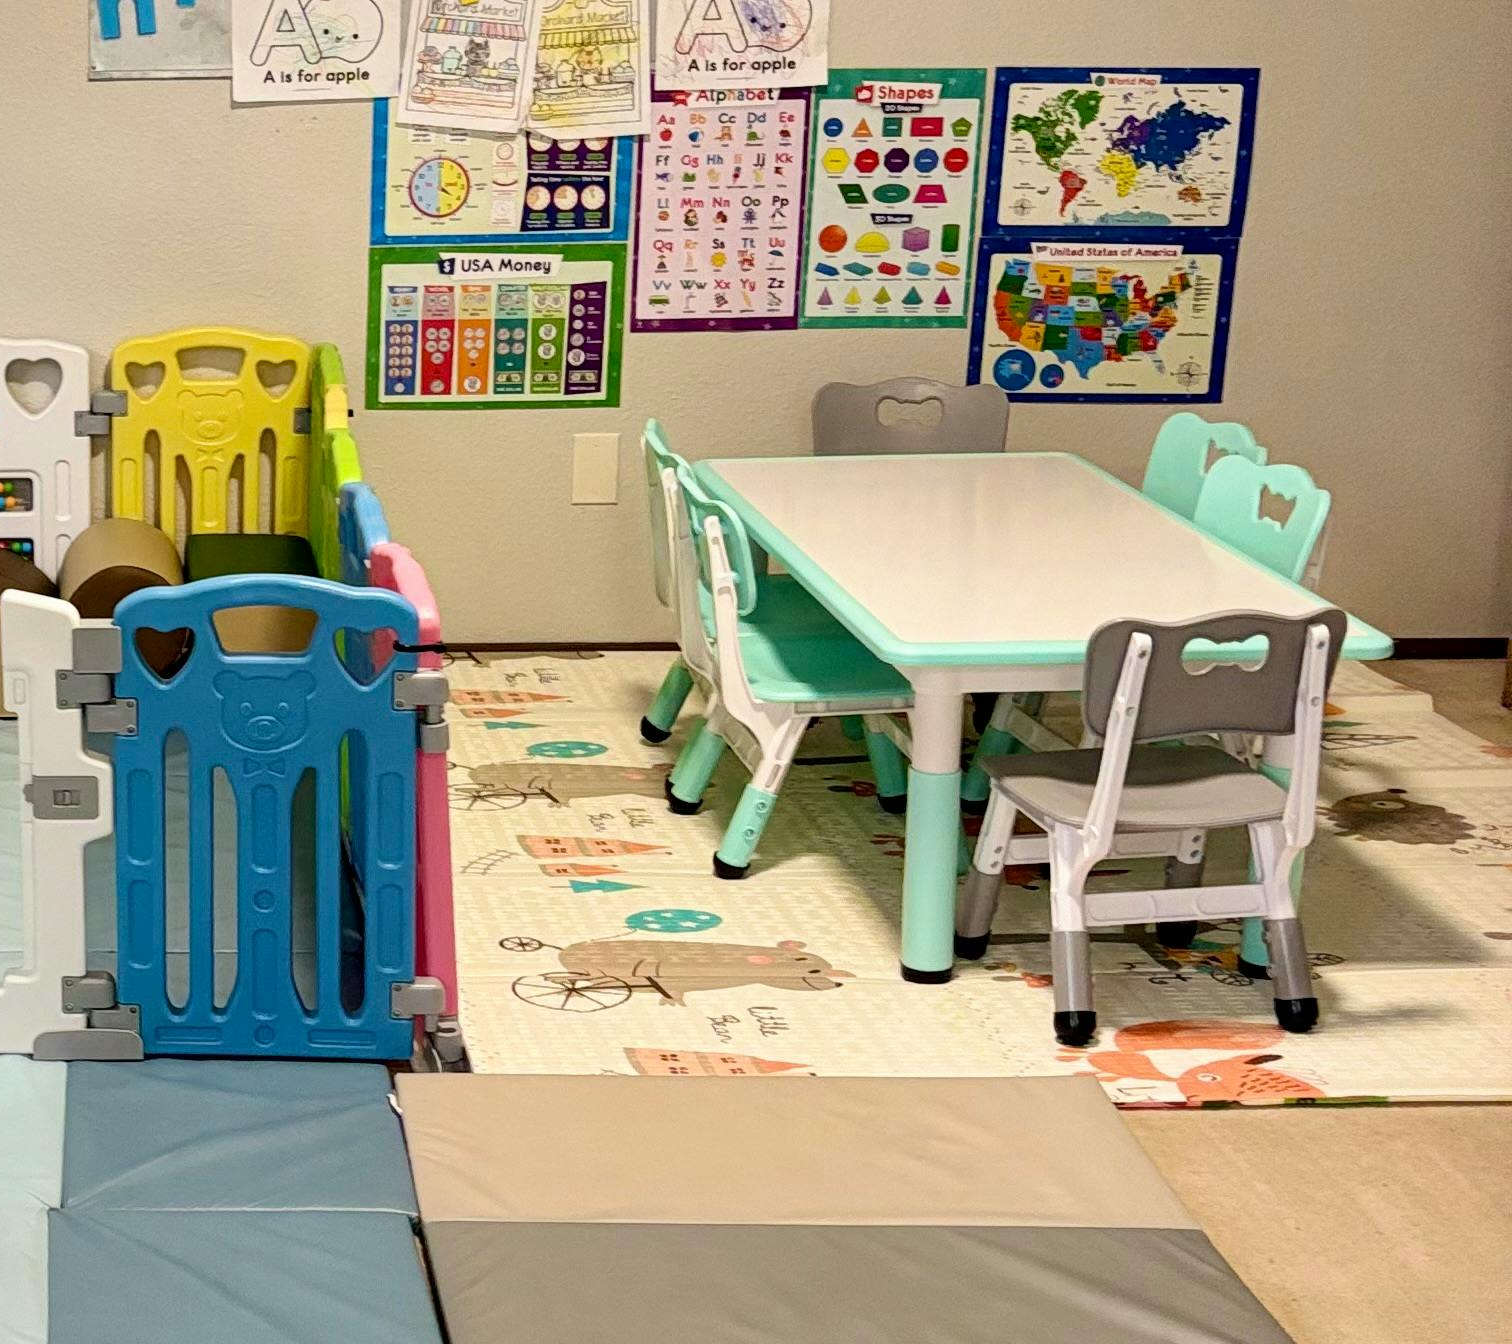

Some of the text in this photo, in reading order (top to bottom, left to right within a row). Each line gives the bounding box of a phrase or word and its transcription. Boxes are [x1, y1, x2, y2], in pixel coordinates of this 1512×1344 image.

[688, 57, 796, 74] A is for apple
[263, 67, 370, 85] A is for apple
[1108, 77, 1157, 86] World Map
[696, 89, 775, 104] Alphabet
[878, 86, 934, 102] Shapes
[656, 114, 676, 125] Aa
[718, 112, 737, 124] Cc
[747, 112, 767, 123] Dd
[778, 111, 796, 123] Ee
[656, 154, 670, 166] Ff
[706, 154, 724, 165] Hh
[753, 153, 766, 167] Jj
[775, 153, 794, 164] Kk
[657, 198, 670, 209] Ll
[680, 197, 704, 208] Mm
[712, 197, 730, 208] Nn
[741, 196, 761, 207] Oo
[772, 195, 790, 209] Pp
[653, 239, 673, 253] Qq
[712, 238, 726, 249] Ss
[741, 237, 756, 248] Tt
[769, 237, 786, 248] Uu
[1049, 247, 1177, 257] United States of America
[461, 259, 494, 273] USA
[498, 259, 552, 275] Money
[652, 280, 672, 290] Vv
[680, 279, 707, 290] Ww
[713, 279, 731, 289] Xx
[740, 278, 756, 291] Yy
[767, 277, 785, 289] Zz
